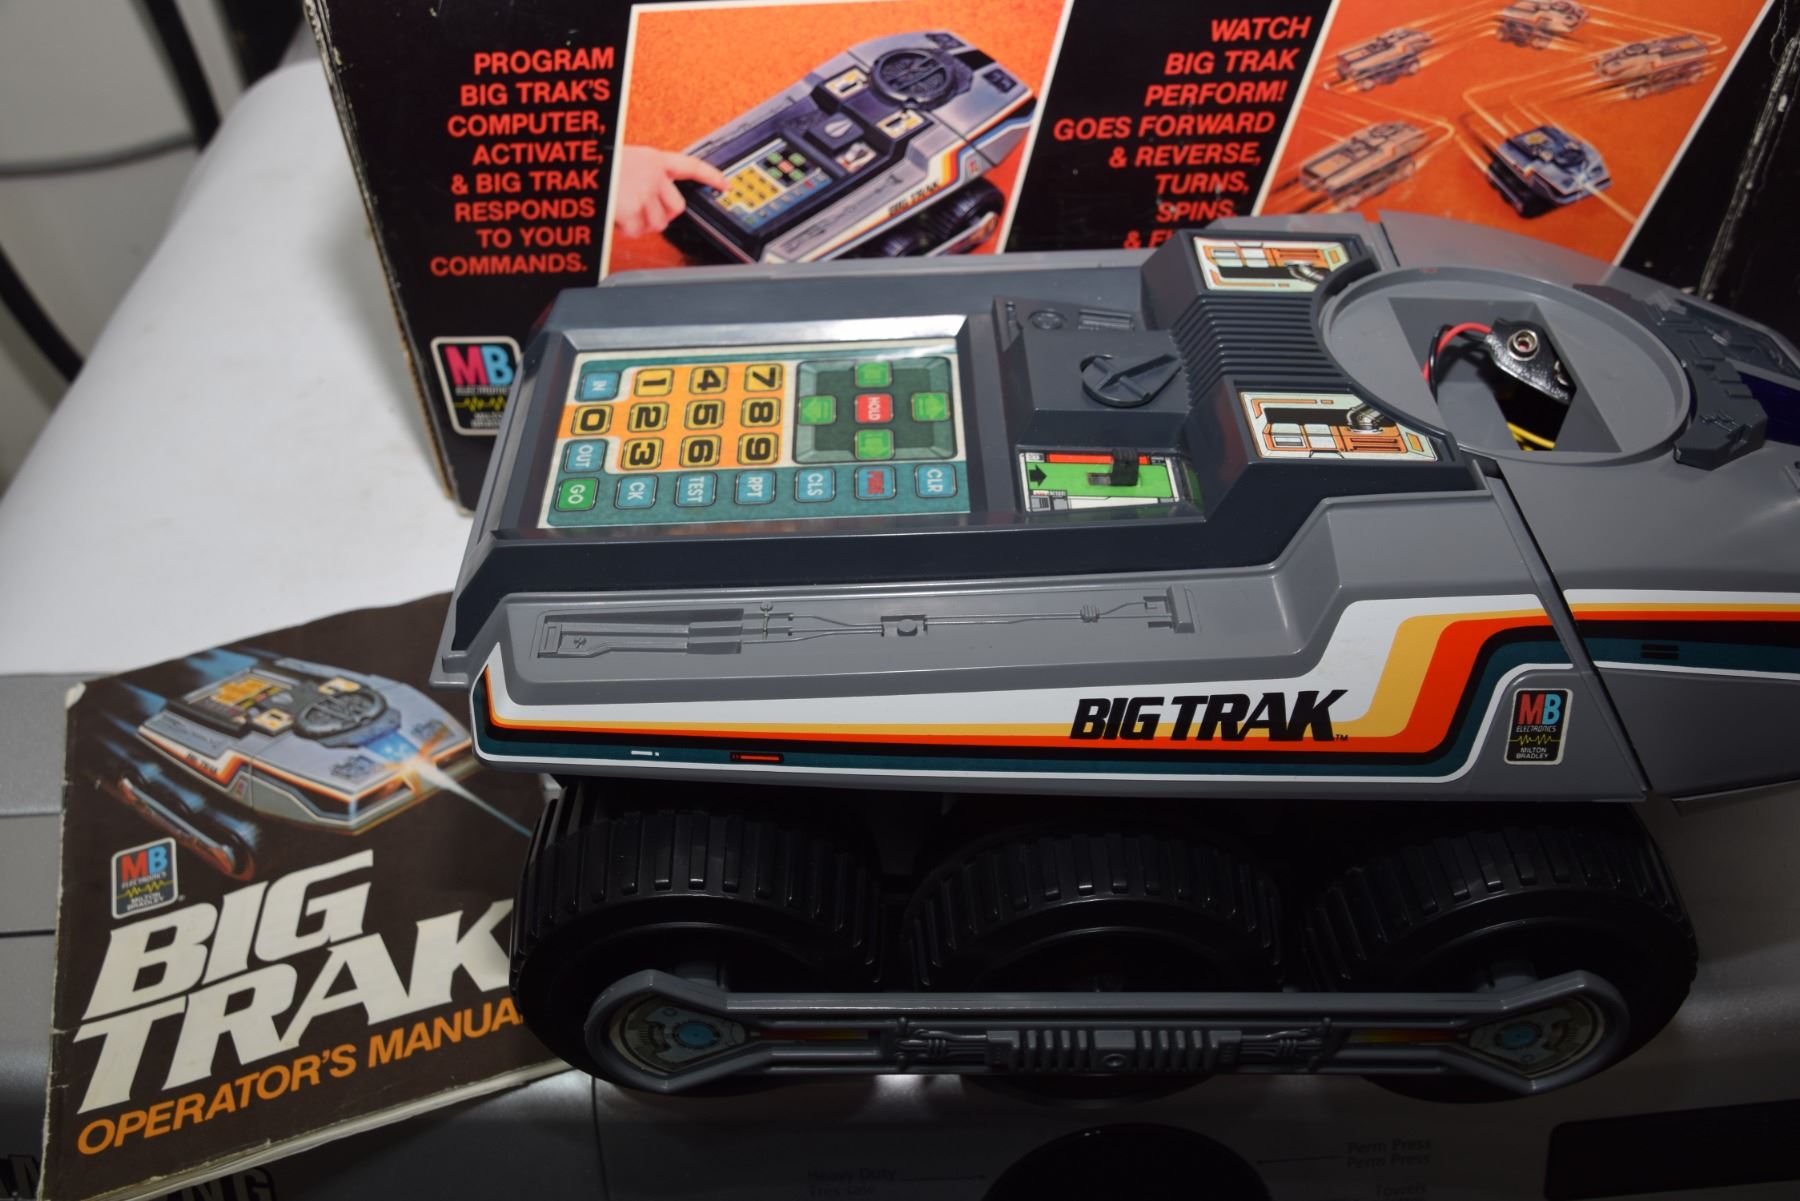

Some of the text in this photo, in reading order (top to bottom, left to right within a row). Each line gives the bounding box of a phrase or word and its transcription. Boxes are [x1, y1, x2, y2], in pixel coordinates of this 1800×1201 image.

[1210, 16, 1312, 42] WATCH
[474, 46, 614, 75] PROGRAM
[1164, 48, 1300, 76] BIG TRAK
[460, 78, 611, 107] BIG TRAK'S
[1144, 80, 1288, 107] PERFORM!
[447, 110, 606, 138] COMPUTER,
[1053, 111, 1276, 141] GOES FORWARD
[471, 140, 604, 166] ACTIVATE,
[1108, 141, 1262, 168] & REVERSE,
[451, 169, 599, 195] & BIG TRAK
[1155, 170, 1249, 195] TURNS,
[454, 197, 595, 223] RESPONDS
[476, 226, 591, 248] TO YOUR
[430, 252, 588, 276] COMMANDS.
[445, 345, 514, 385] MB
[752, 367, 776, 388] 7
[643, 378, 667, 387] 1
[697, 369, 721, 391] 4
[635, 406, 661, 429] 2
[693, 403, 718, 425] 5
[749, 402, 774, 423] 8
[868, 396, 881, 421] HOLD
[575, 444, 594, 467] OUT
[629, 443, 655, 466] 3
[688, 439, 714, 463] 6
[746, 437, 771, 461] 9
[627, 481, 646, 501] CK
[687, 476, 705, 503] TEST
[747, 476, 763, 498] RPT
[807, 472, 824, 497] CLS
[927, 468, 944, 494] CLR
[567, 484, 586, 505] GO
[1069, 696, 1165, 740] BIG
[1170, 689, 1349, 742] TRAK
[1519, 693, 1561, 725] MB
[121, 846, 167, 882] MB
[80, 849, 373, 1020] BIG
[73, 898, 513, 1114] TRAK
[77, 996, 524, 1155] OPERATOR'S MANUA
